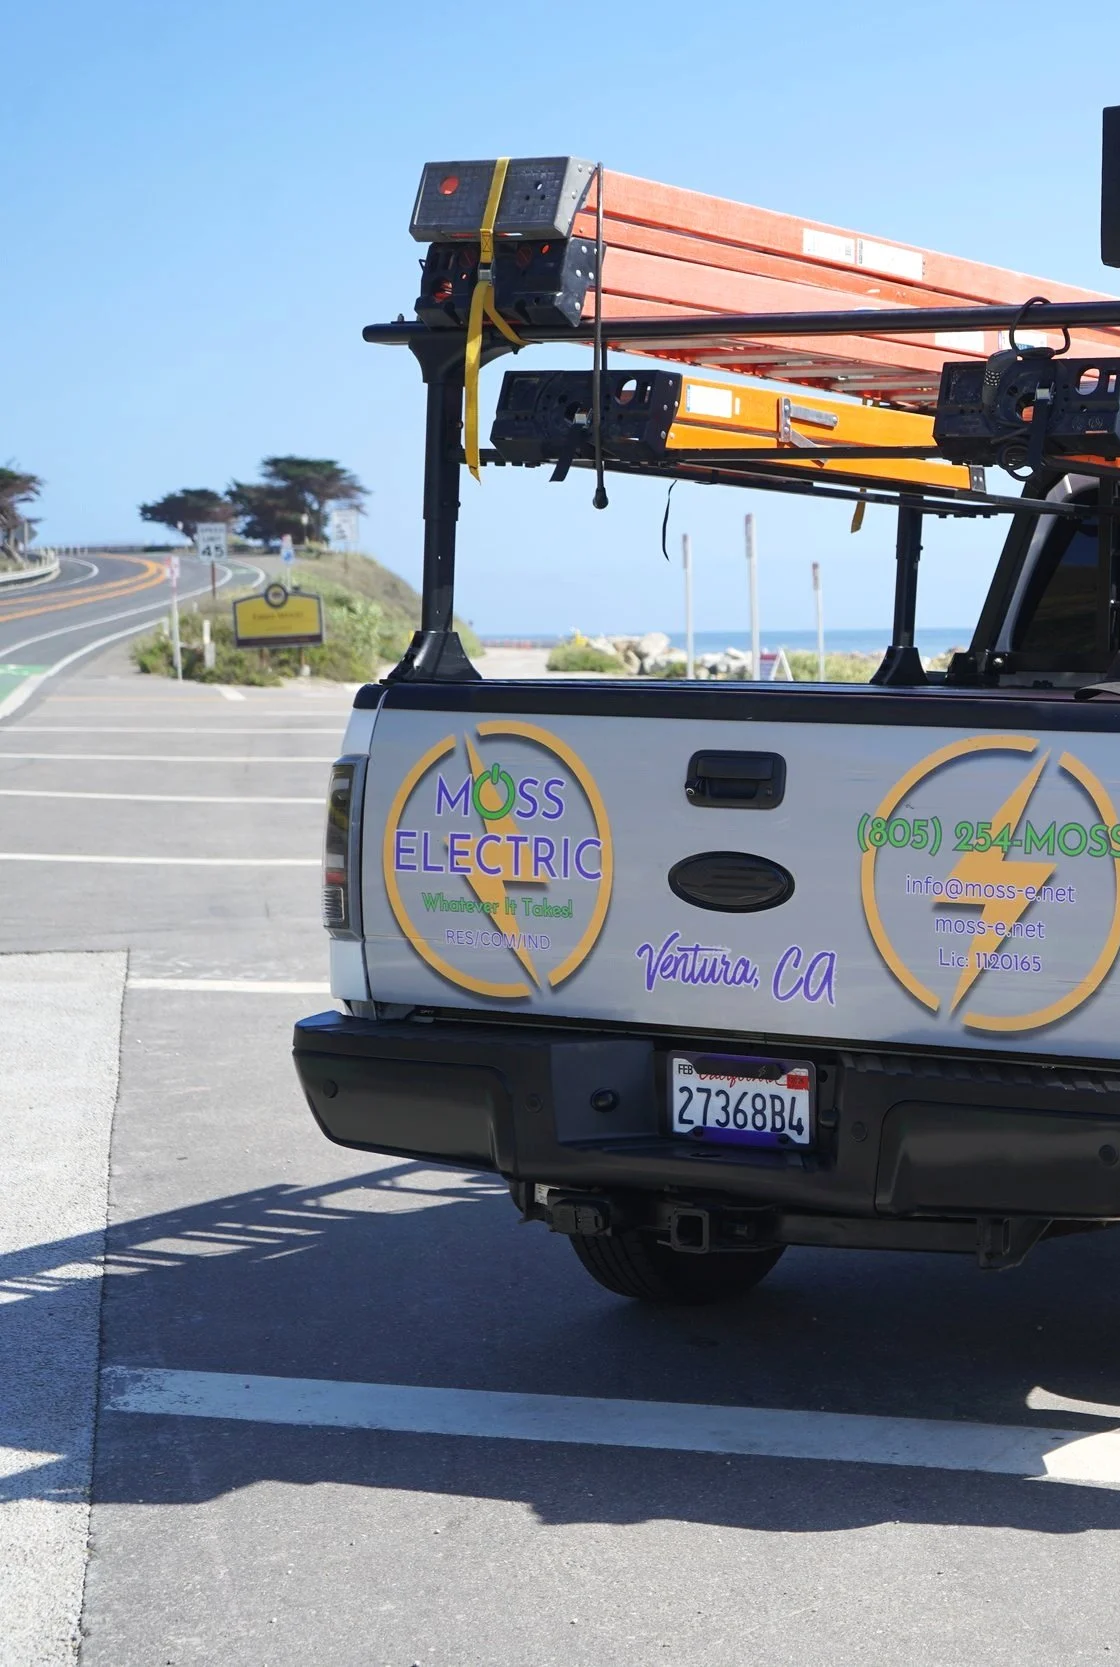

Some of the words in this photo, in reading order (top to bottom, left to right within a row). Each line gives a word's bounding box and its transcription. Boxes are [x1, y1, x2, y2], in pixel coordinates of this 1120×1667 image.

[202, 545, 225, 558] 45
[435, 763, 565, 820] MOSS
[857, 813, 943, 857] (805)
[394, 830, 603, 880] ELECTRIC
[906, 875, 1076, 903] info@moss-e.net
[421, 892, 500, 916] Whatever
[504, 896, 518, 917] It
[521, 897, 574, 920] Takes!
[445, 928, 551, 952] RES/COM/IND
[935, 917, 1046, 940] moss-e.net
[637, 932, 760, 992] Ventura,
[772, 944, 837, 1005] CA
[938, 947, 970, 969] Lic:
[974, 950, 1043, 974] 1120165
[677, 1063, 694, 1076] FEB
[678, 1086, 804, 1135] 27368B4
